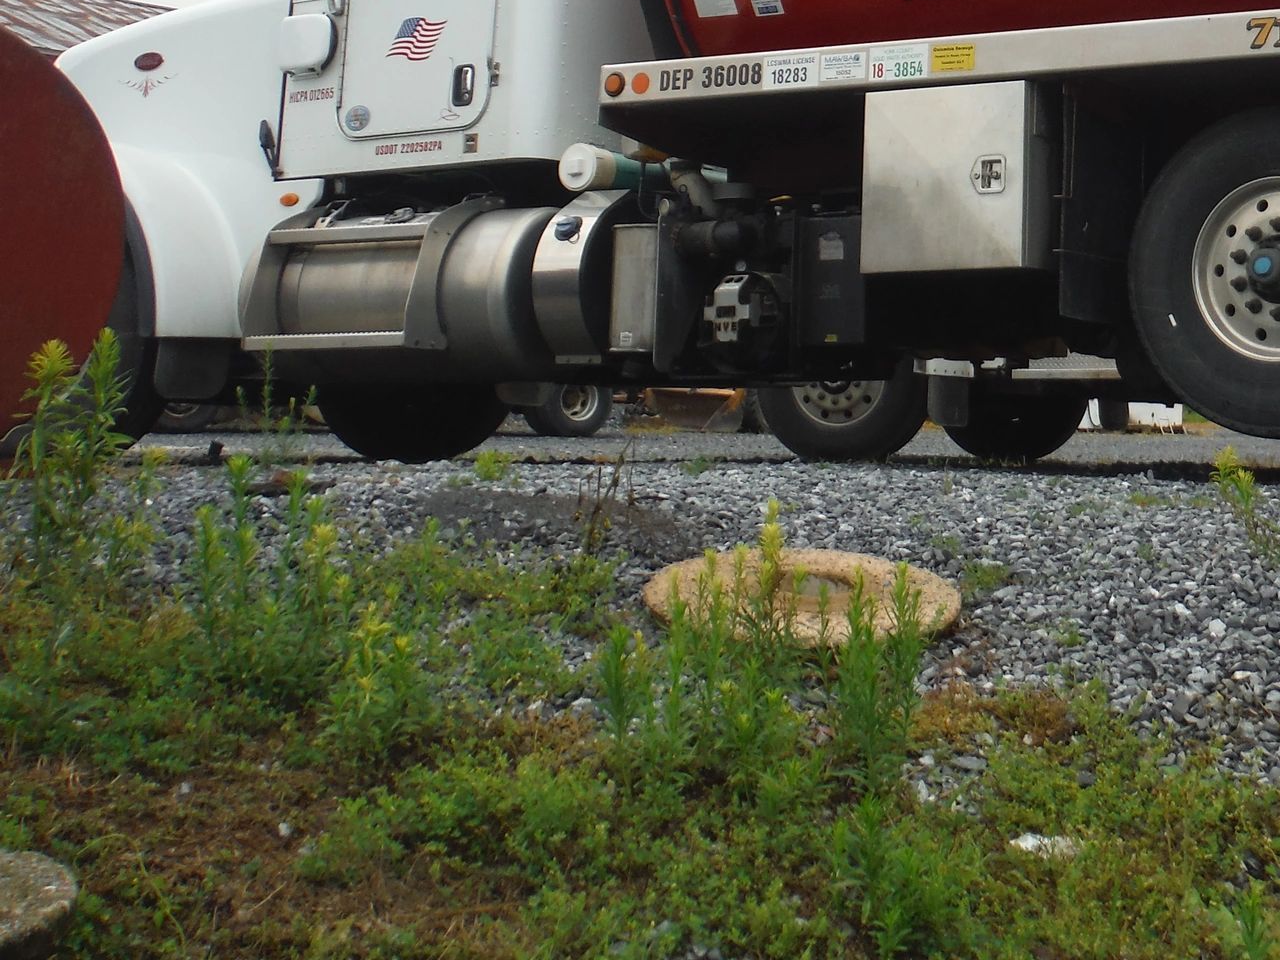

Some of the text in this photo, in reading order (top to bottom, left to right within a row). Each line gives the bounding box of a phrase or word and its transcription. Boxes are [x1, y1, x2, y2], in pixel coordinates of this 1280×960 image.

[660, 63, 762, 91] DEP 36008
[771, 67, 808, 85] 18283
[872, 61, 924, 79] 18-3854
[375, 144, 398, 156] USDOT
